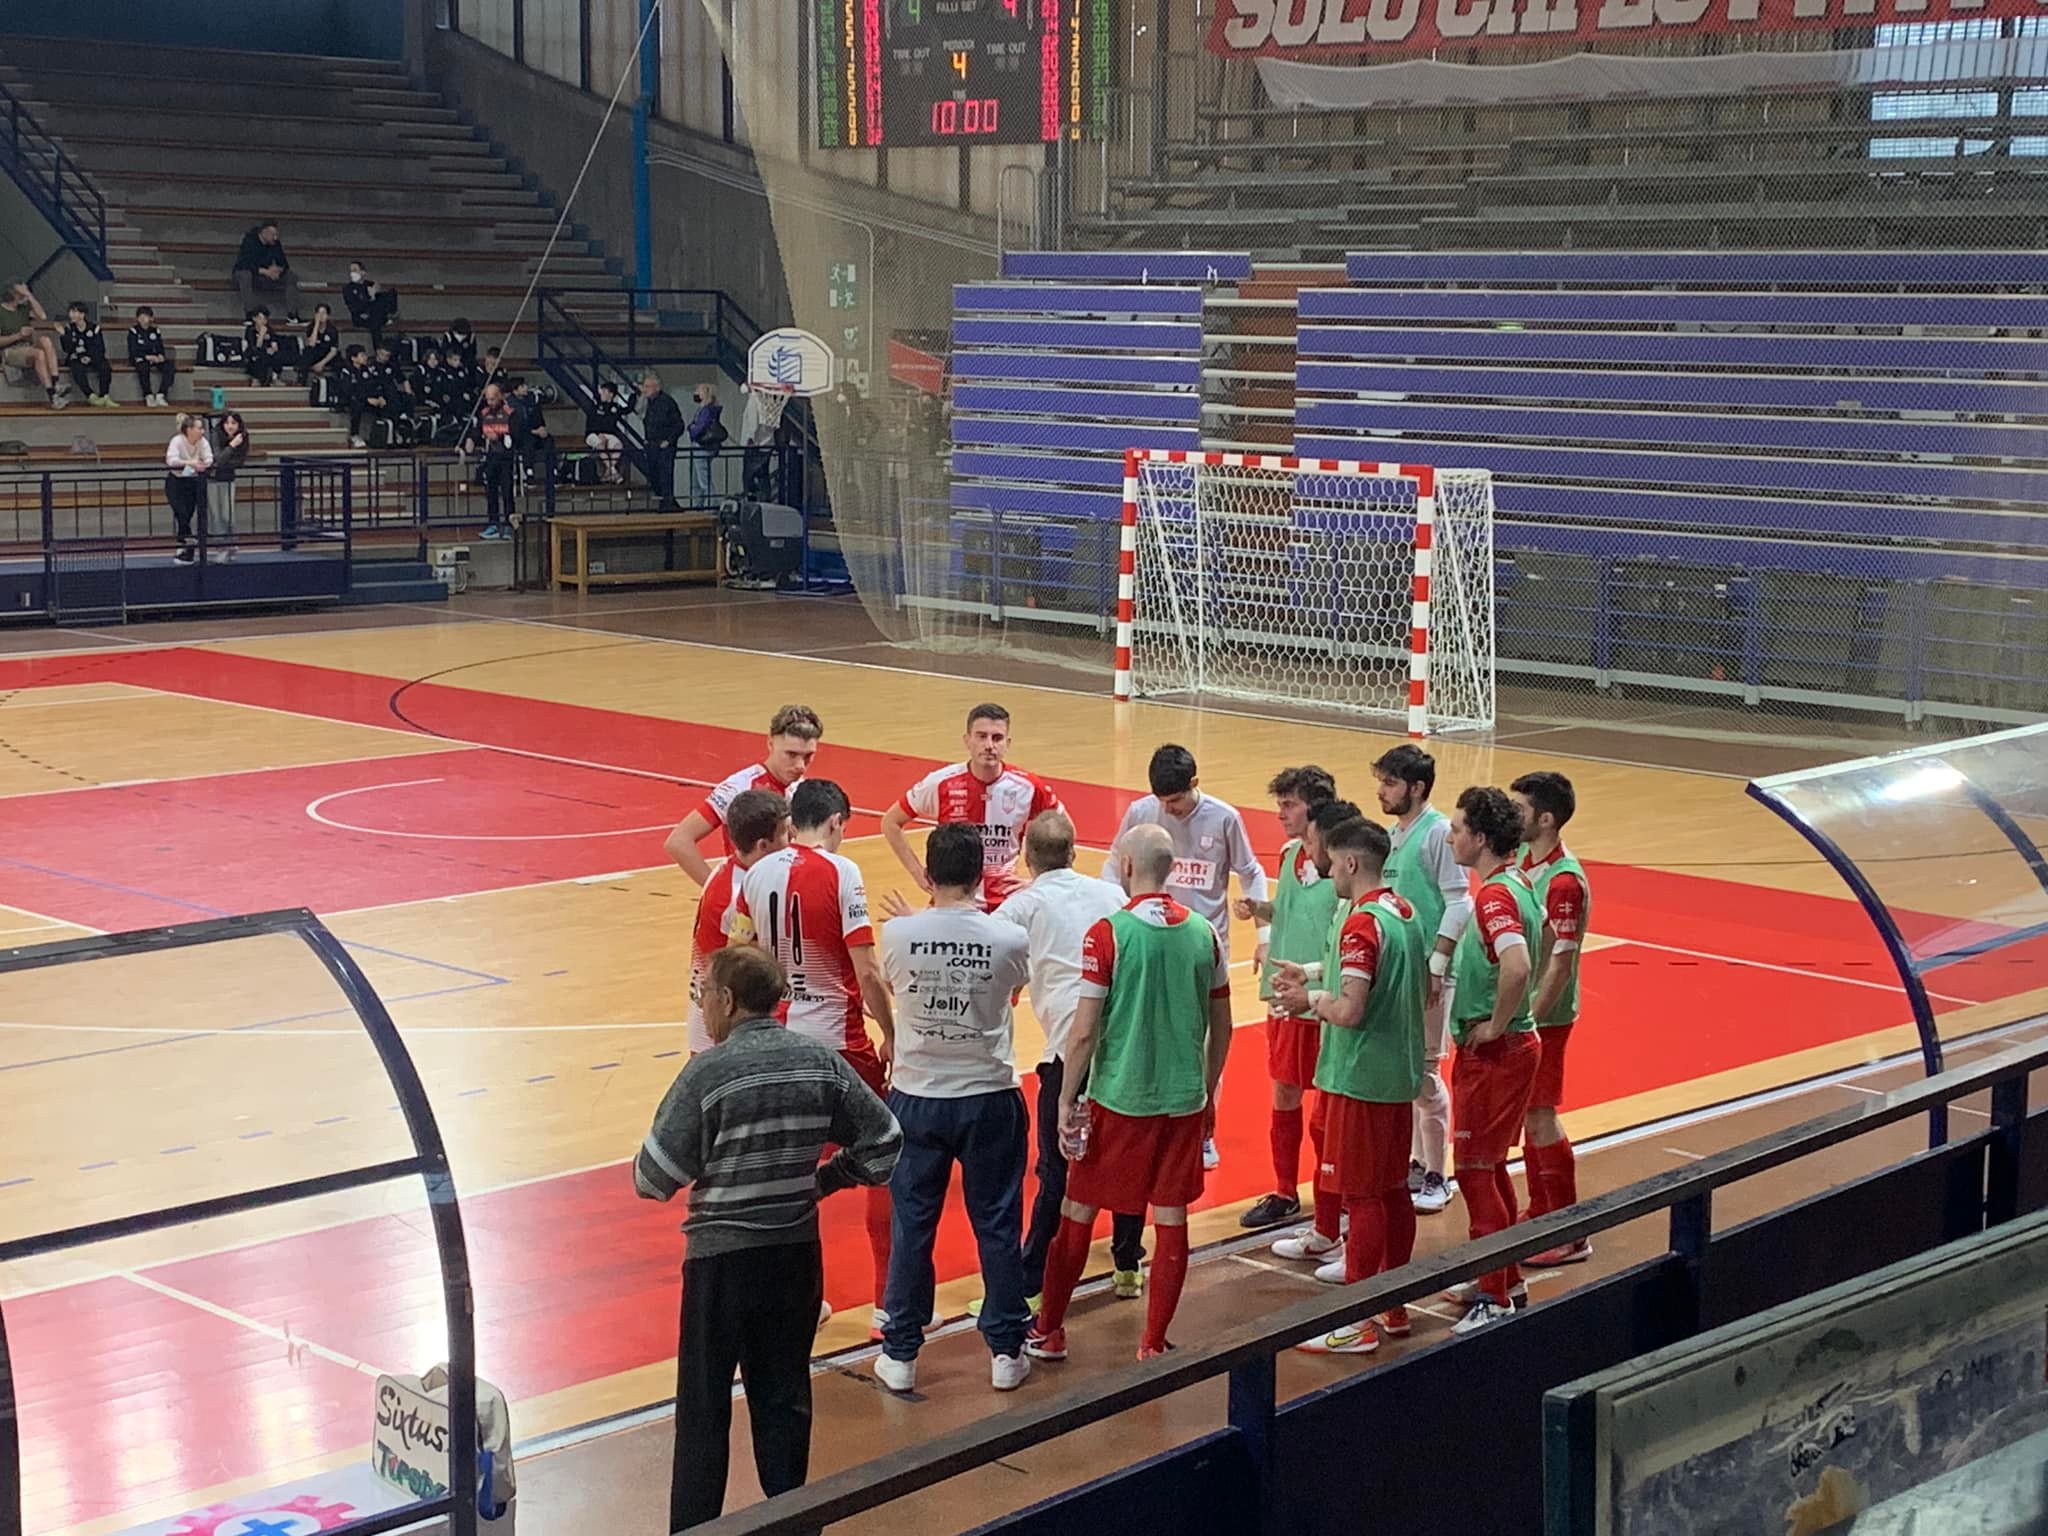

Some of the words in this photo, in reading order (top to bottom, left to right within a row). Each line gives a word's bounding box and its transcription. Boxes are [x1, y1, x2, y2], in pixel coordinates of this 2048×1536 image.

[953, 52, 967, 79] 4
[910, 941, 992, 957] rimini
[946, 957, 990, 969] .com
[923, 996, 970, 1016] Jolly
